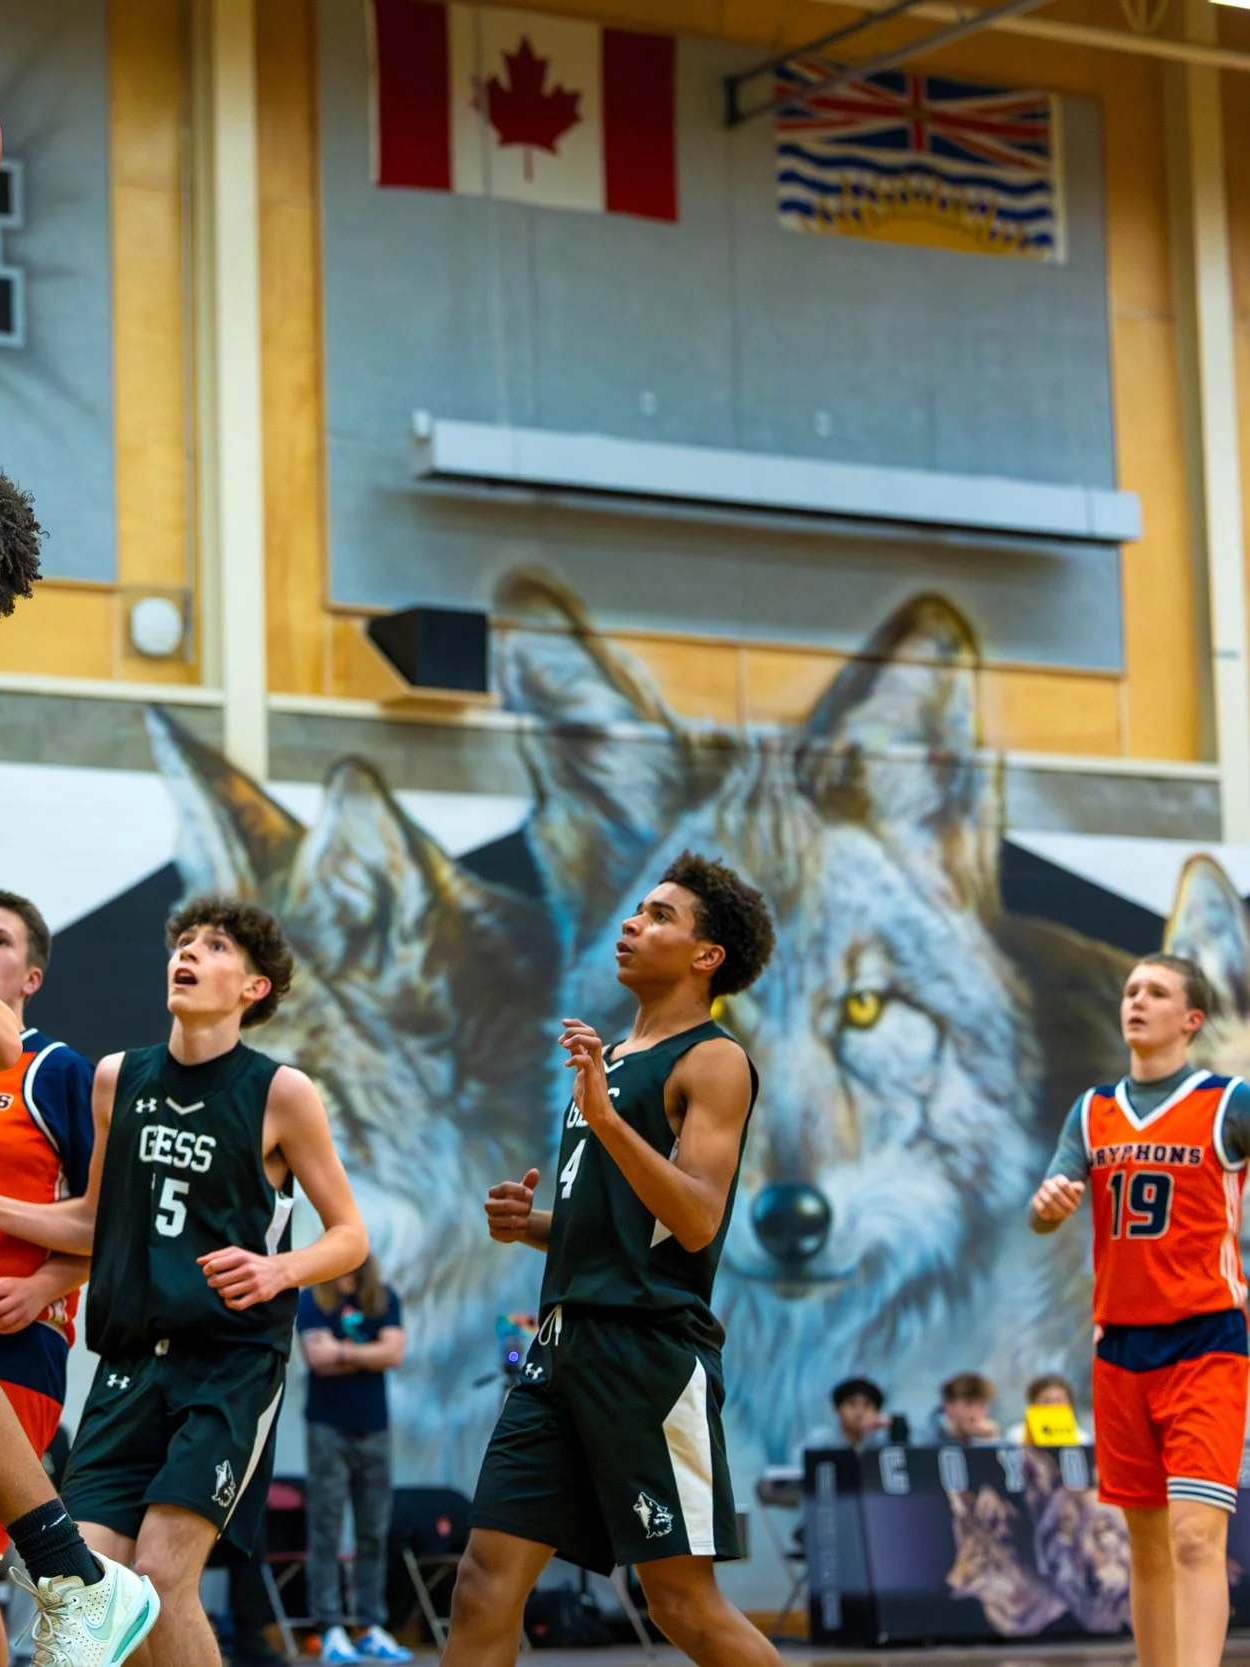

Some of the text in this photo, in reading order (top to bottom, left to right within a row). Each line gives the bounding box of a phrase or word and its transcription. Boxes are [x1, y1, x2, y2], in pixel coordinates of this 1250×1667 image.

[139, 1125, 217, 1173] GESS
[560, 1138, 587, 1200] 4
[1091, 1143, 1203, 1170] RYPHONS
[152, 1173, 191, 1238] 5
[1107, 1169, 1175, 1240] 19
[878, 1446, 1091, 1495] COYO
